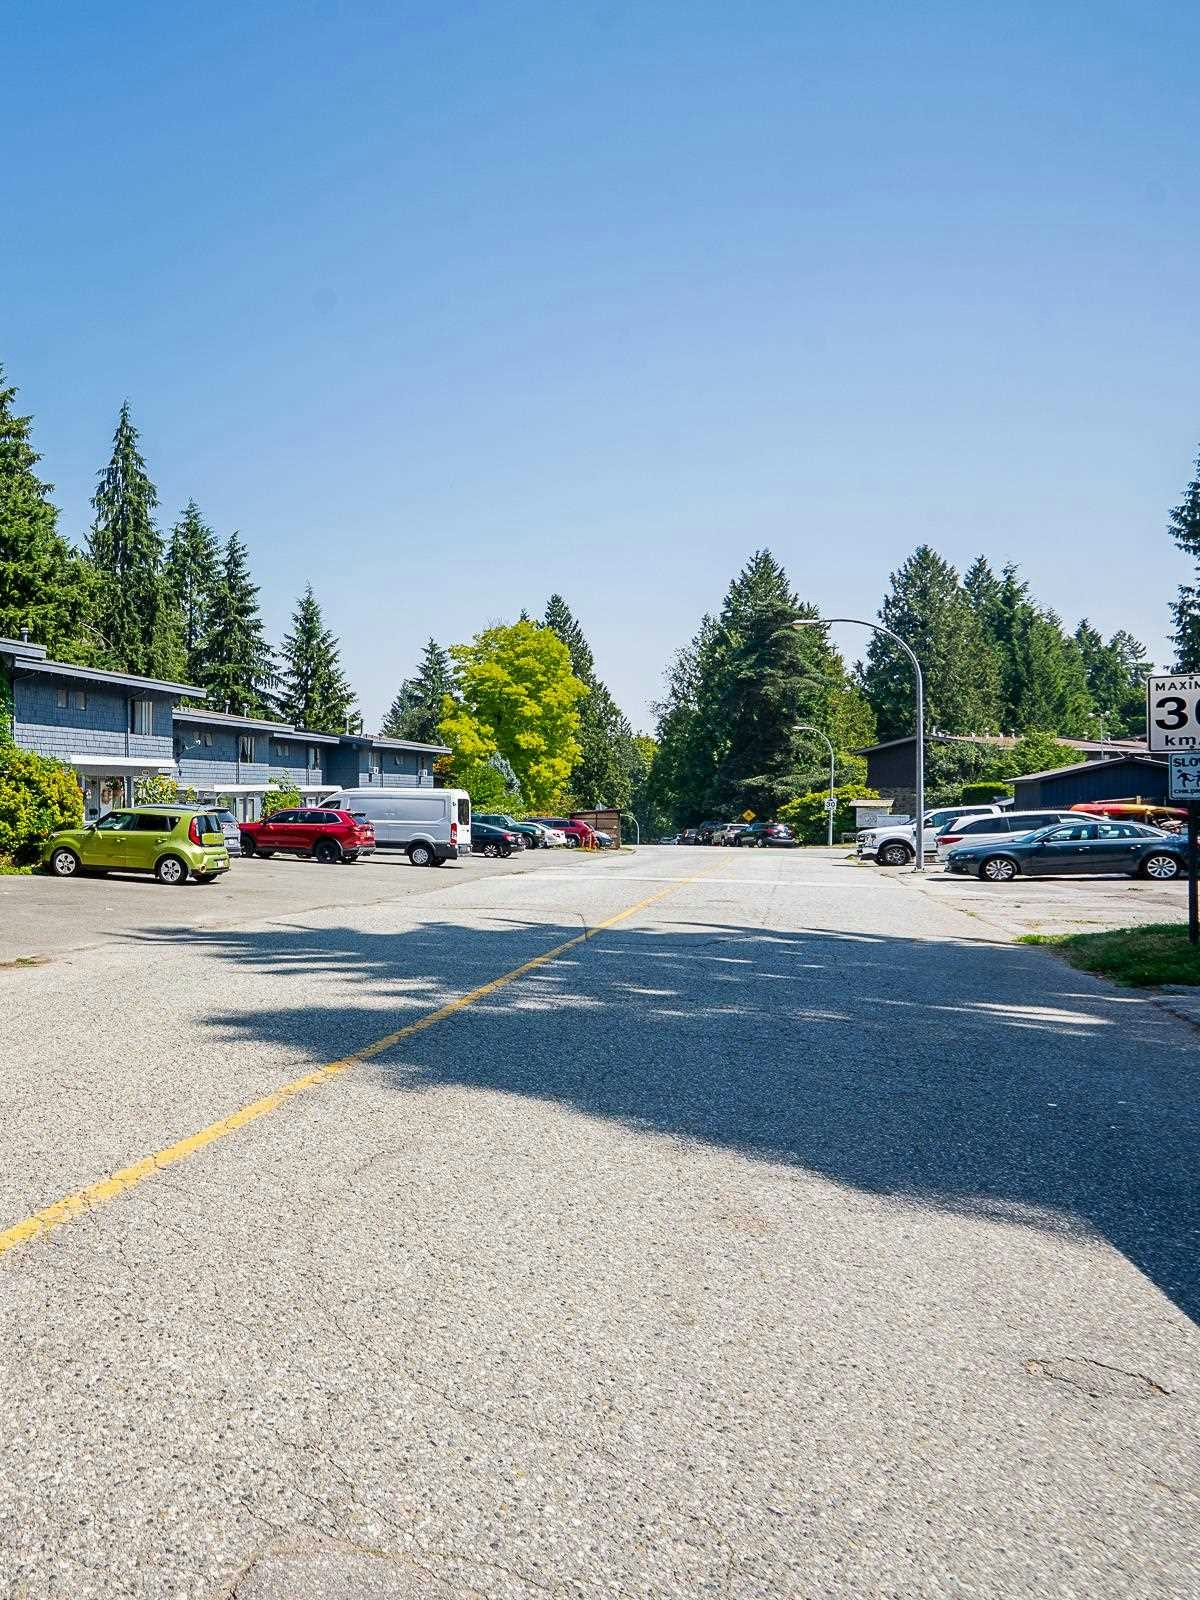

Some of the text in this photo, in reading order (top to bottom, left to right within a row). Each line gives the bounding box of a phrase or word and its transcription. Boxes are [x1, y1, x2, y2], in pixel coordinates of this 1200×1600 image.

[1155, 696, 1200, 730] 3
[1165, 735, 1200, 746] km
[1173, 757, 1200, 768] SLO
